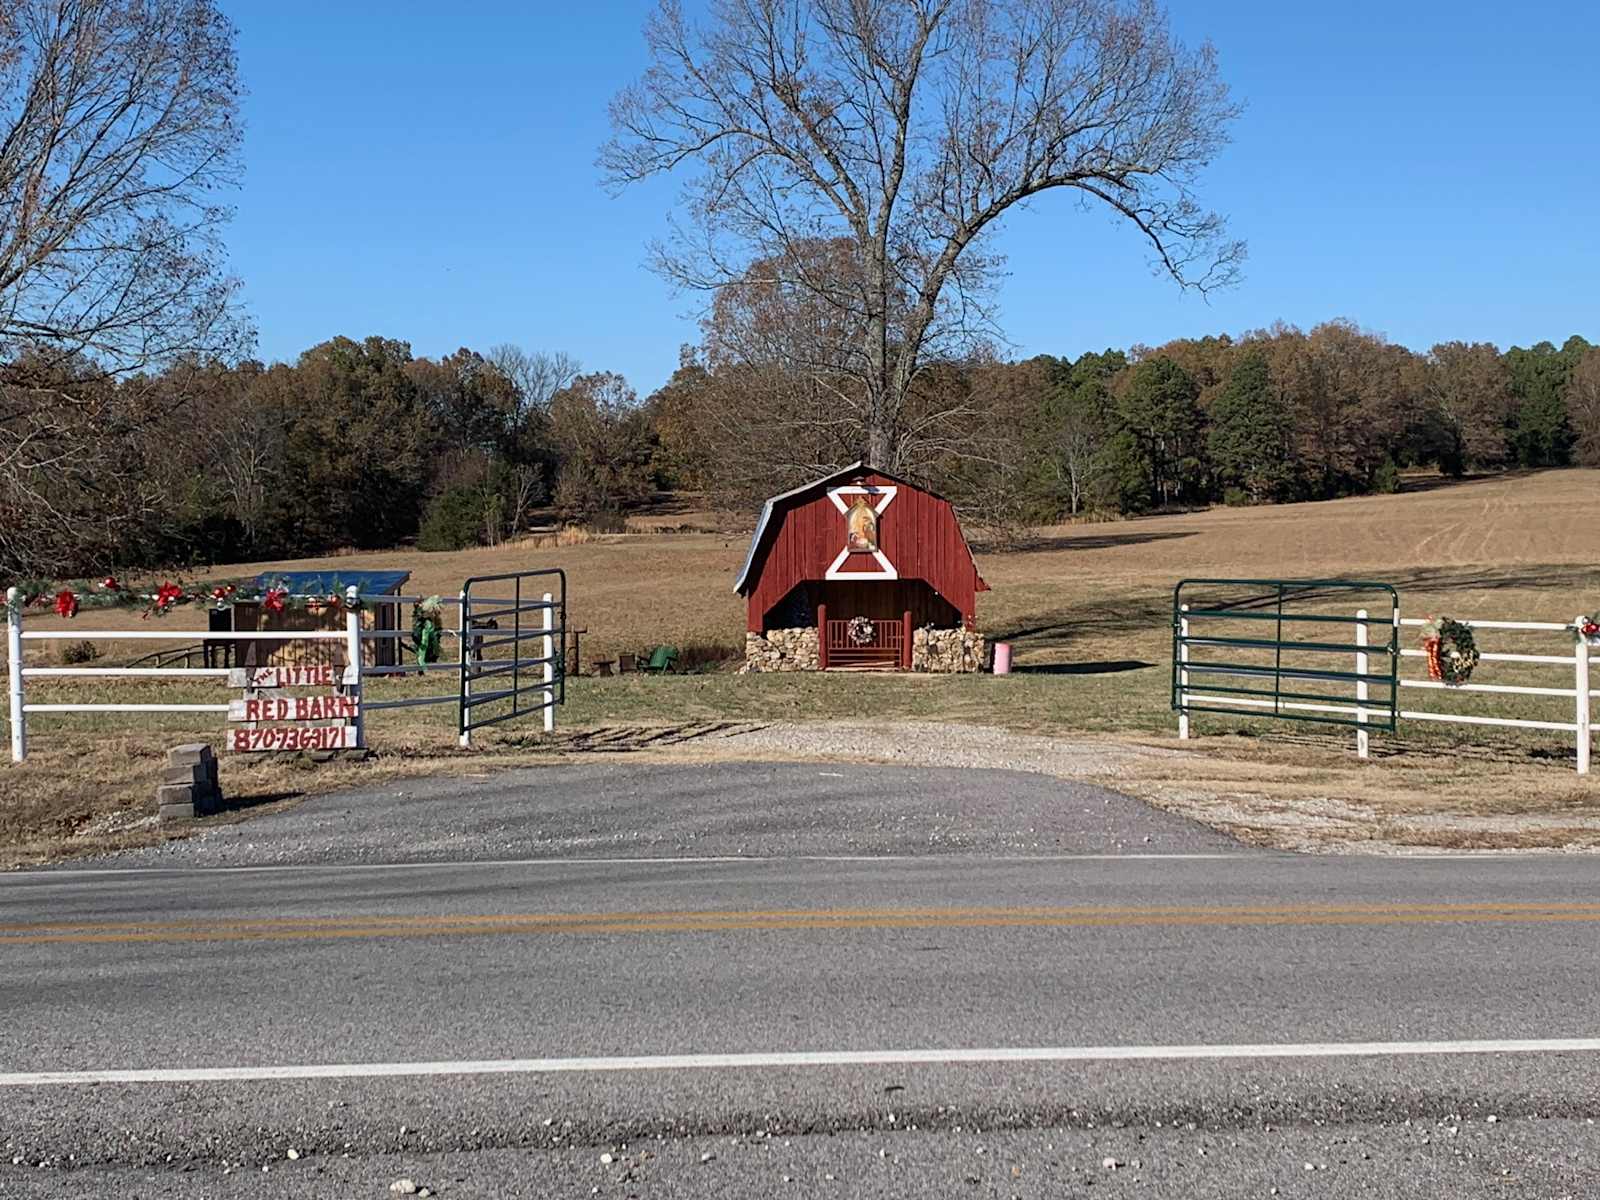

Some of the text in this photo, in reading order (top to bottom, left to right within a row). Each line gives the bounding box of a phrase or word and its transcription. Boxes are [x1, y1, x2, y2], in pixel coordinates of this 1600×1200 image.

[255, 665, 334, 688] THE LITTLE
[247, 696, 355, 721] RED BARN
